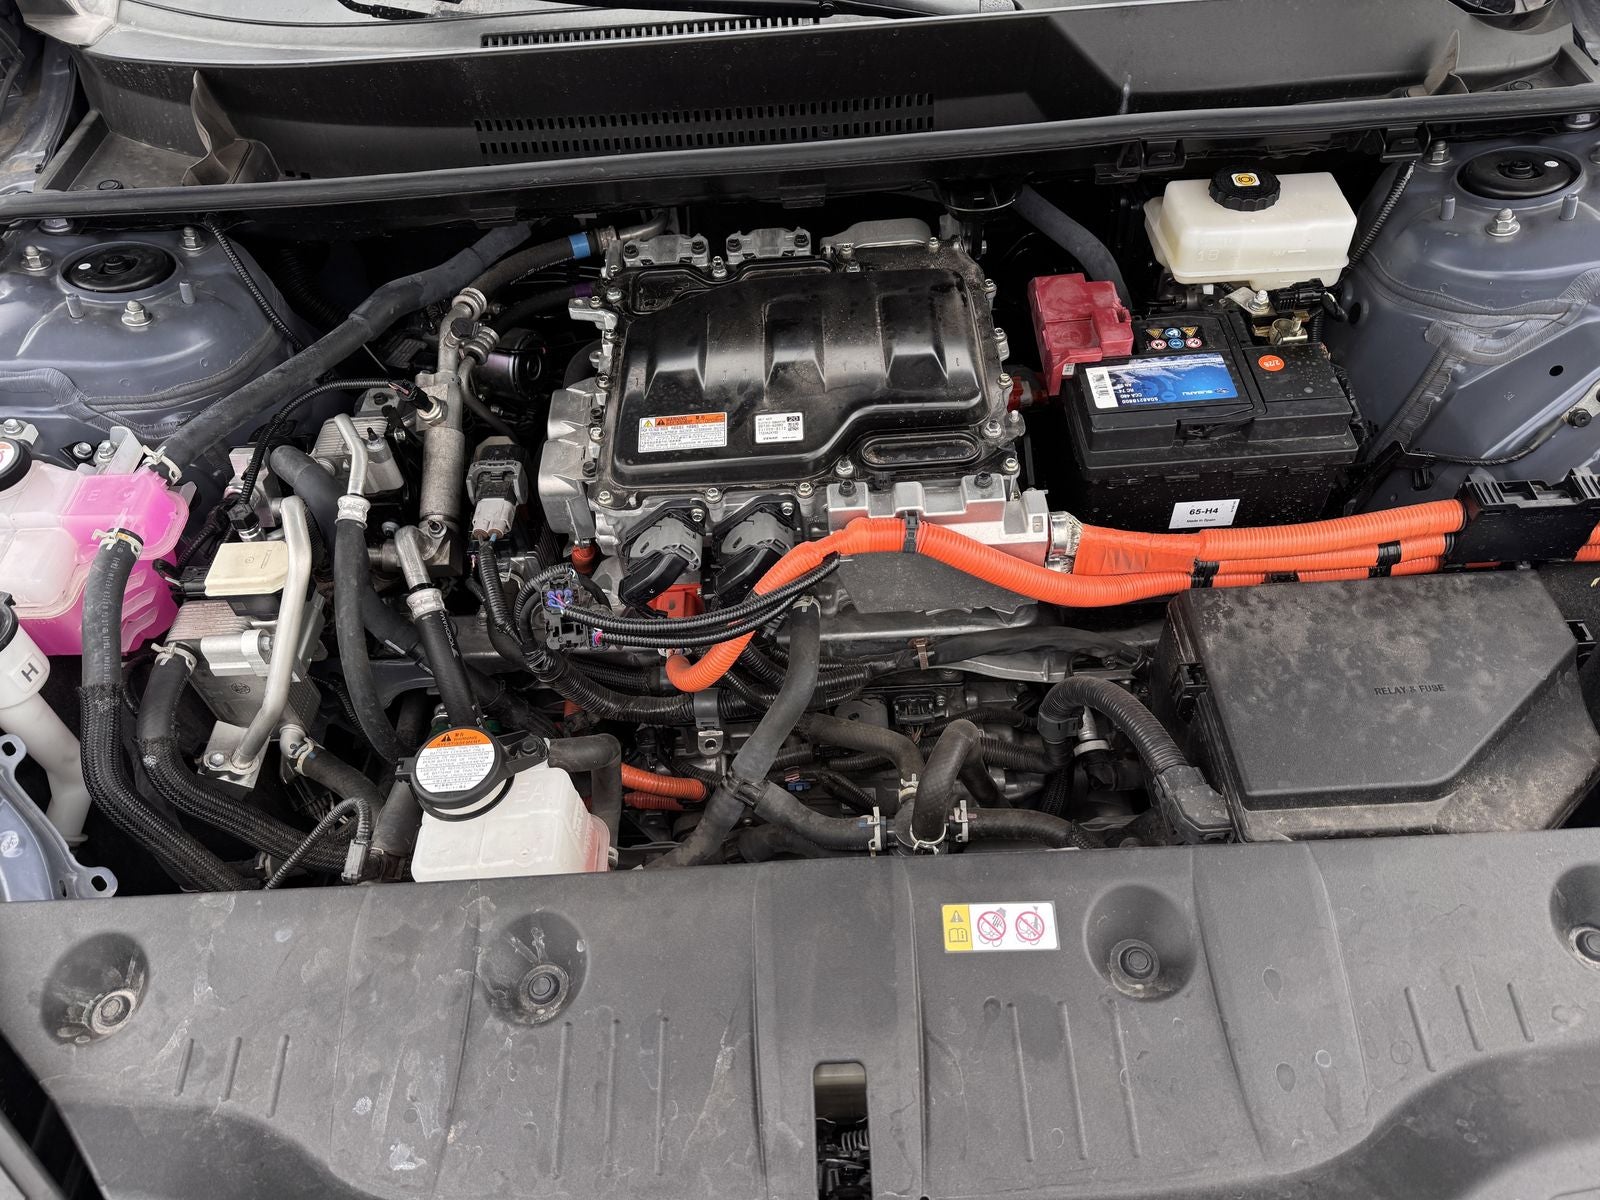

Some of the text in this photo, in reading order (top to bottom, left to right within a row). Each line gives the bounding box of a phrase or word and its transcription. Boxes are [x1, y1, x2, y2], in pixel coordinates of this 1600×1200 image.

[1189, 507, 1219, 515] 65-H4
[21, 662, 39, 683] H
[1374, 686, 1406, 696] RELAY
[1419, 684, 1447, 693] FUSE
